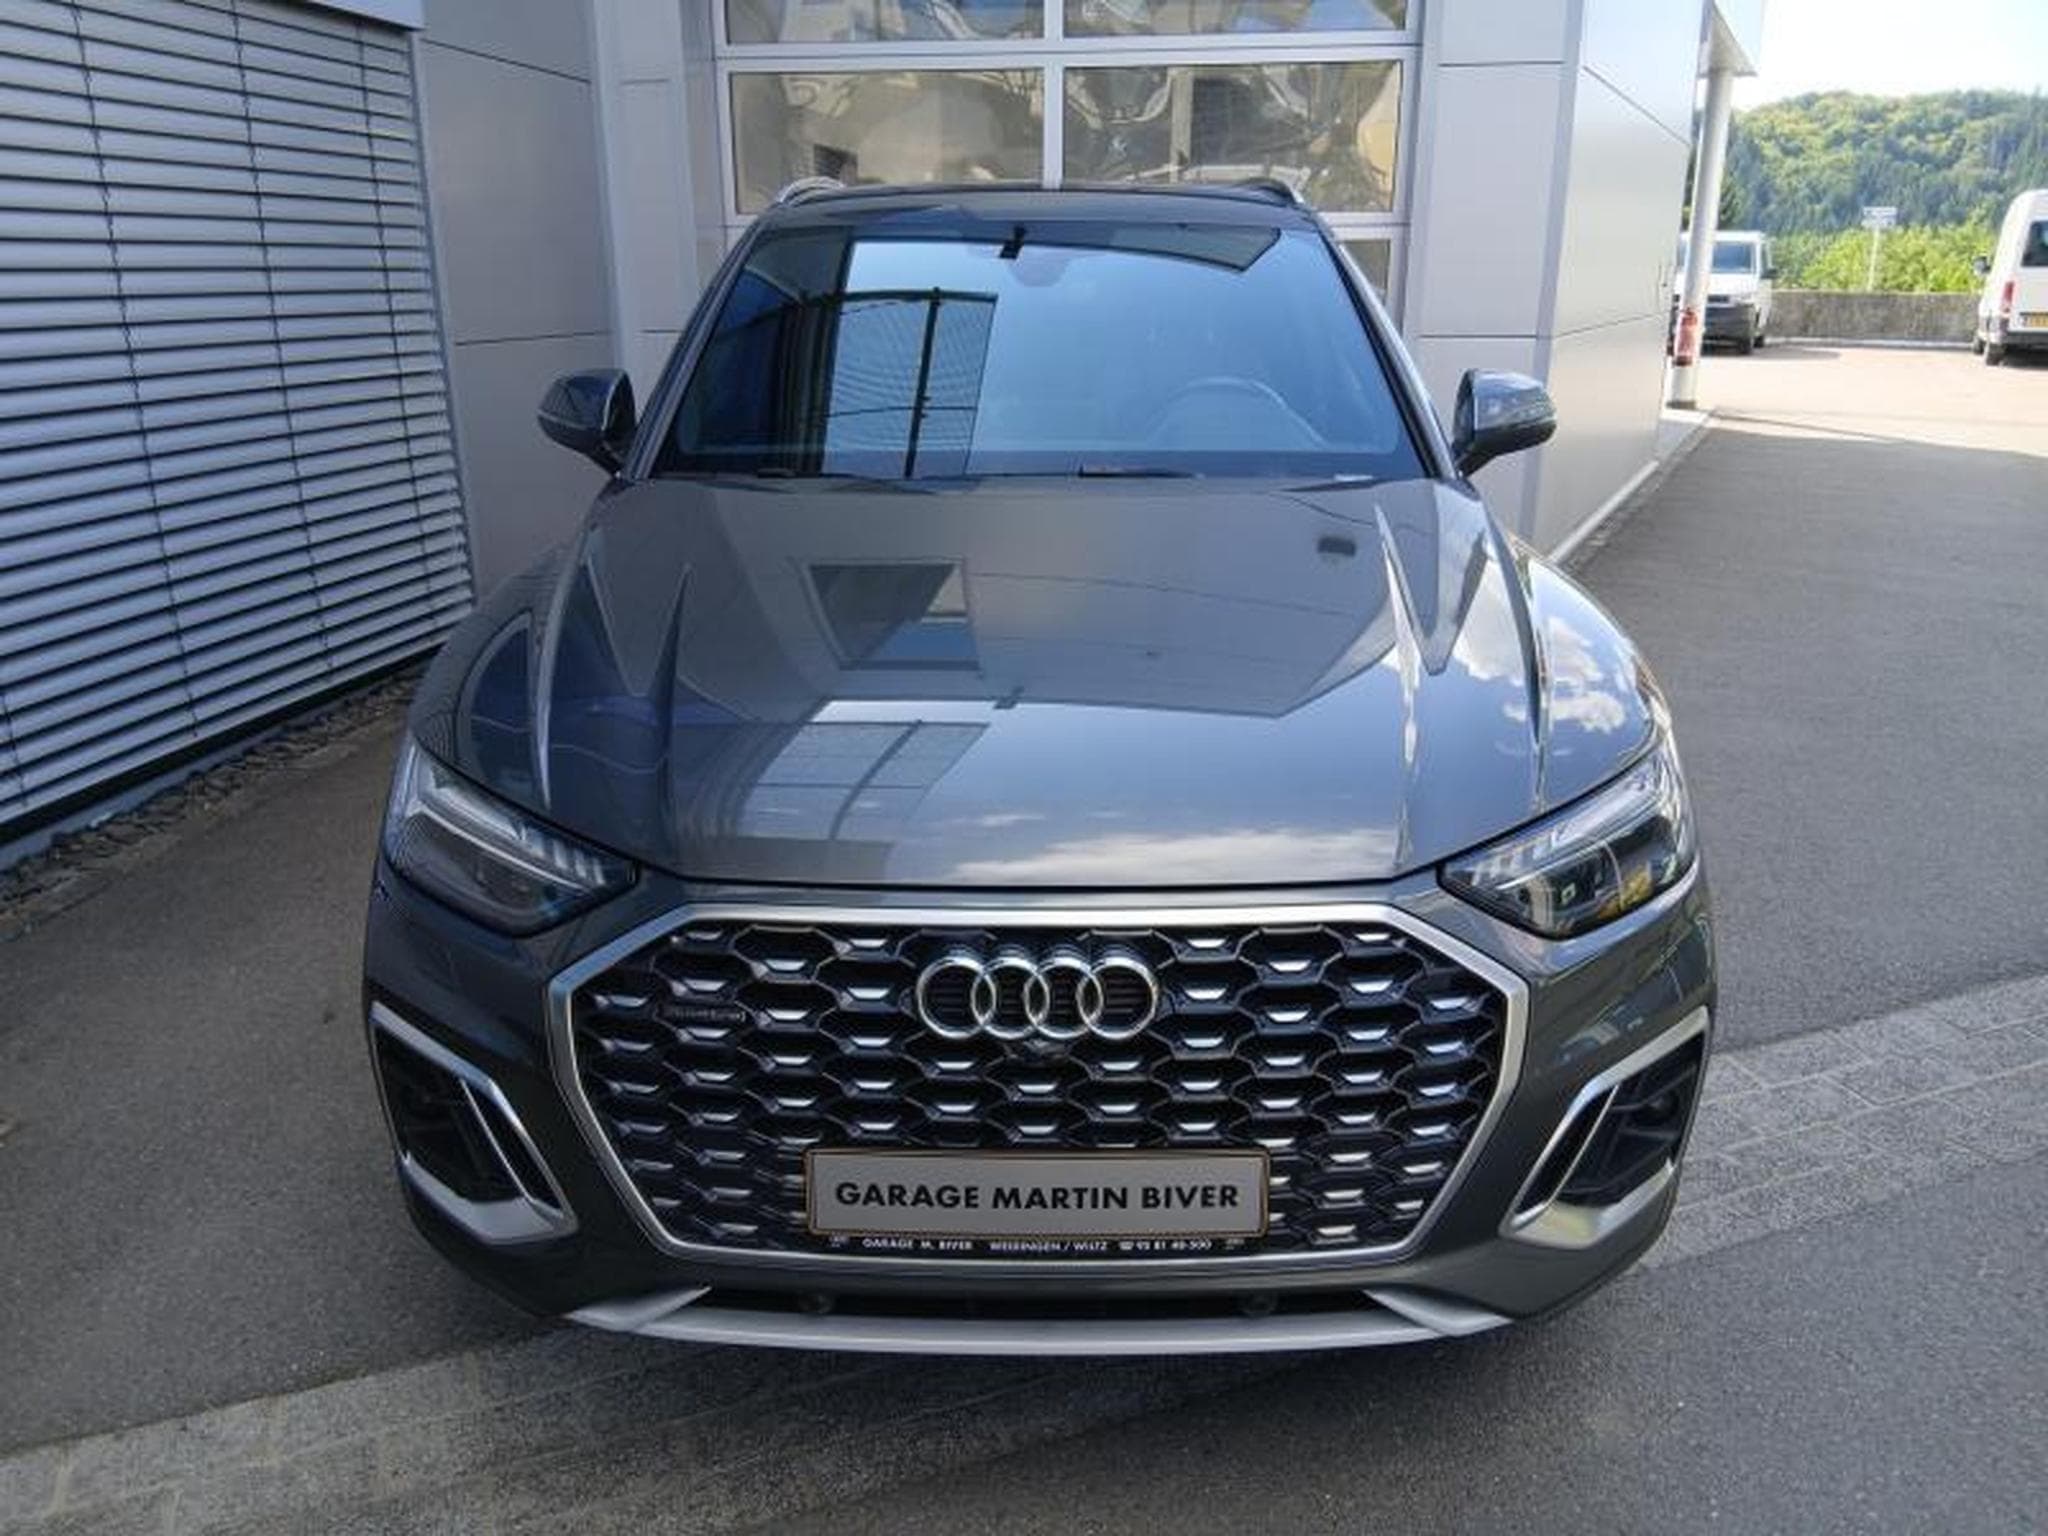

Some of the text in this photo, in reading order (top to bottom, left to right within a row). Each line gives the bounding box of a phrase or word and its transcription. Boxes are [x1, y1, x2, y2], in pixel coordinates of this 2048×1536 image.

[836, 1183, 1239, 1210] GARAGE MARTIN BIVER
[862, 1238, 913, 1249] GARAGE
